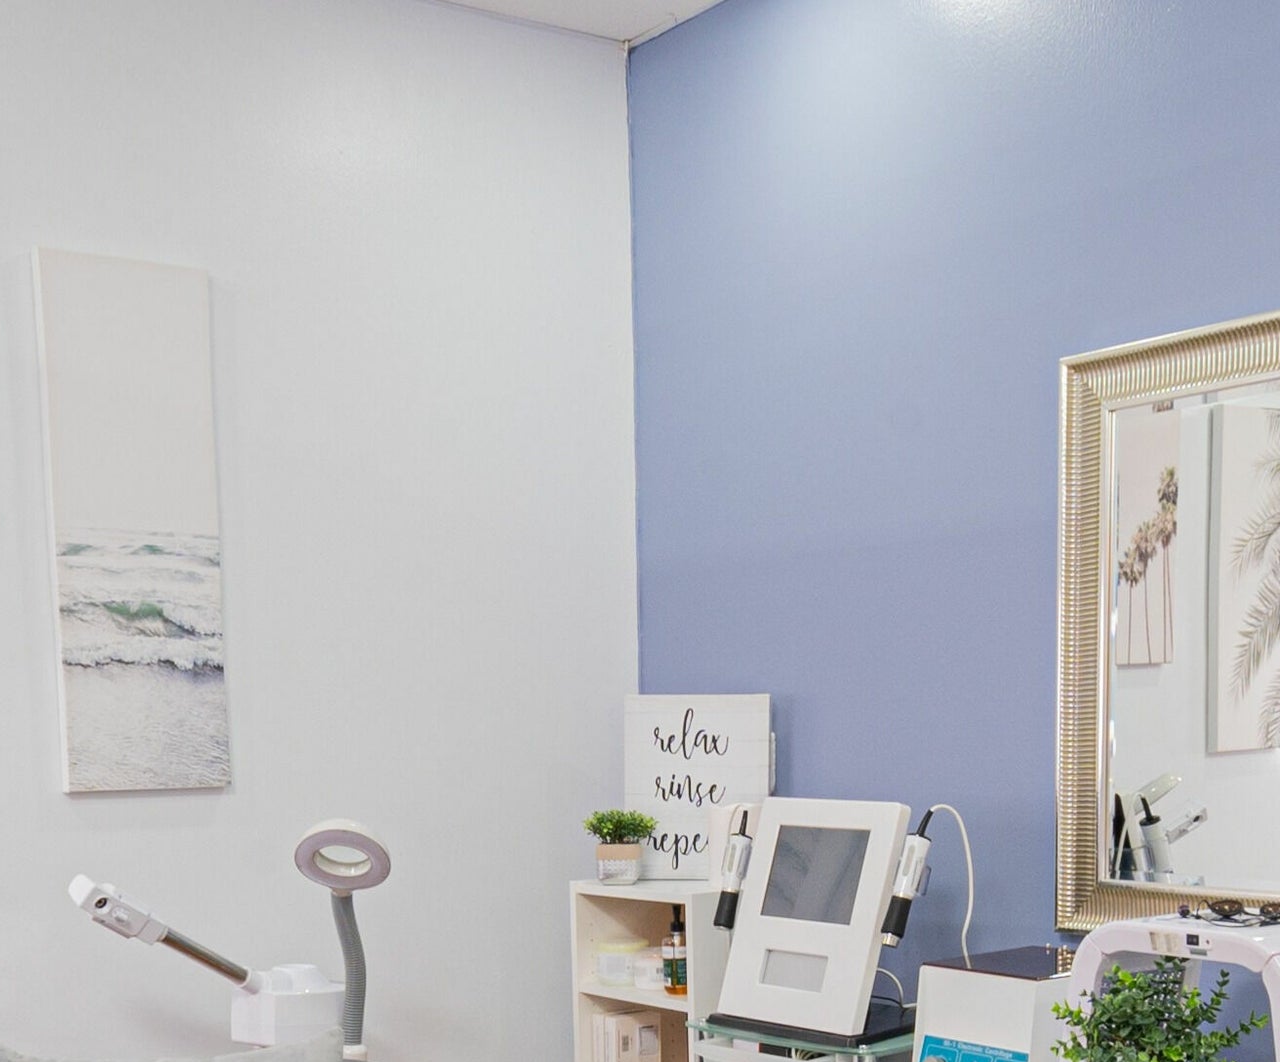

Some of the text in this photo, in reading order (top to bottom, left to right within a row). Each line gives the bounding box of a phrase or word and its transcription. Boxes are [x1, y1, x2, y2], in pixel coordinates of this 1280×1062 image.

[653, 707, 729, 760] relax
[655, 774, 726, 807] rinse
[646, 832, 709, 871] repe
